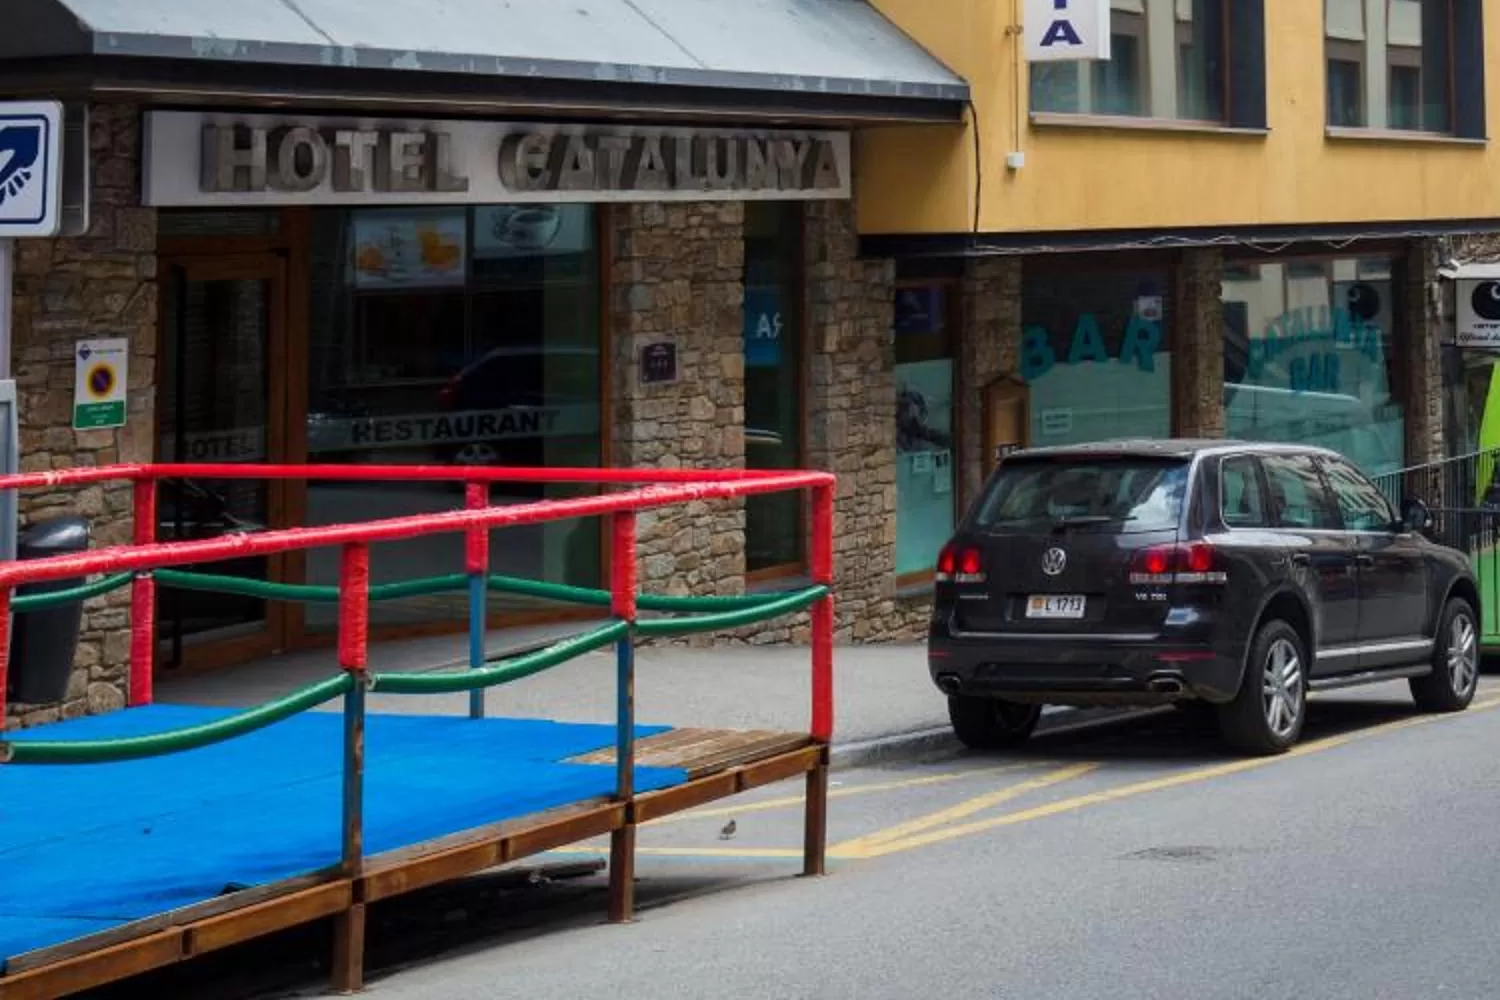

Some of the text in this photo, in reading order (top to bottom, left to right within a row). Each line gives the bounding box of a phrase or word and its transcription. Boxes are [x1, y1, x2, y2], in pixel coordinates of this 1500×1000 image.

[203, 124, 841, 192] HOTEL CATALUNYA
[1021, 311, 1164, 380] BAR
[352, 409, 559, 444] RESTAURANT
